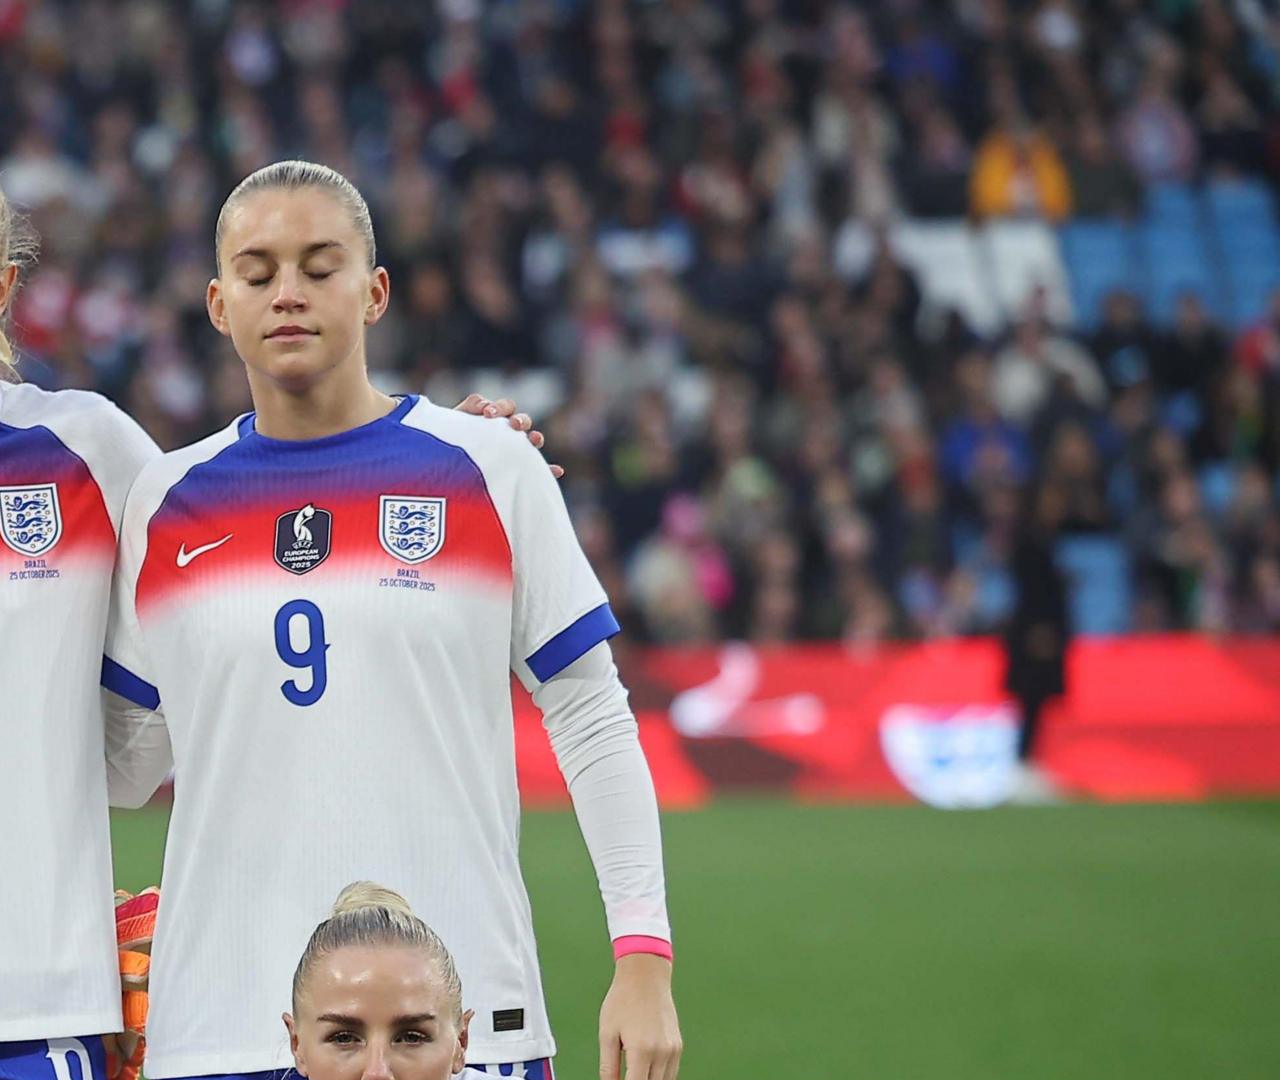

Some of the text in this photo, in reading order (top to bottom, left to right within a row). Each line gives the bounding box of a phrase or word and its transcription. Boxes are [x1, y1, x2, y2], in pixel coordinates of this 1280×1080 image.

[284, 549, 318, 557] EUROPEAN
[282, 554, 320, 562] CHAMPIONS
[379, 578, 388, 586] 25
[274, 599, 330, 707] 9
